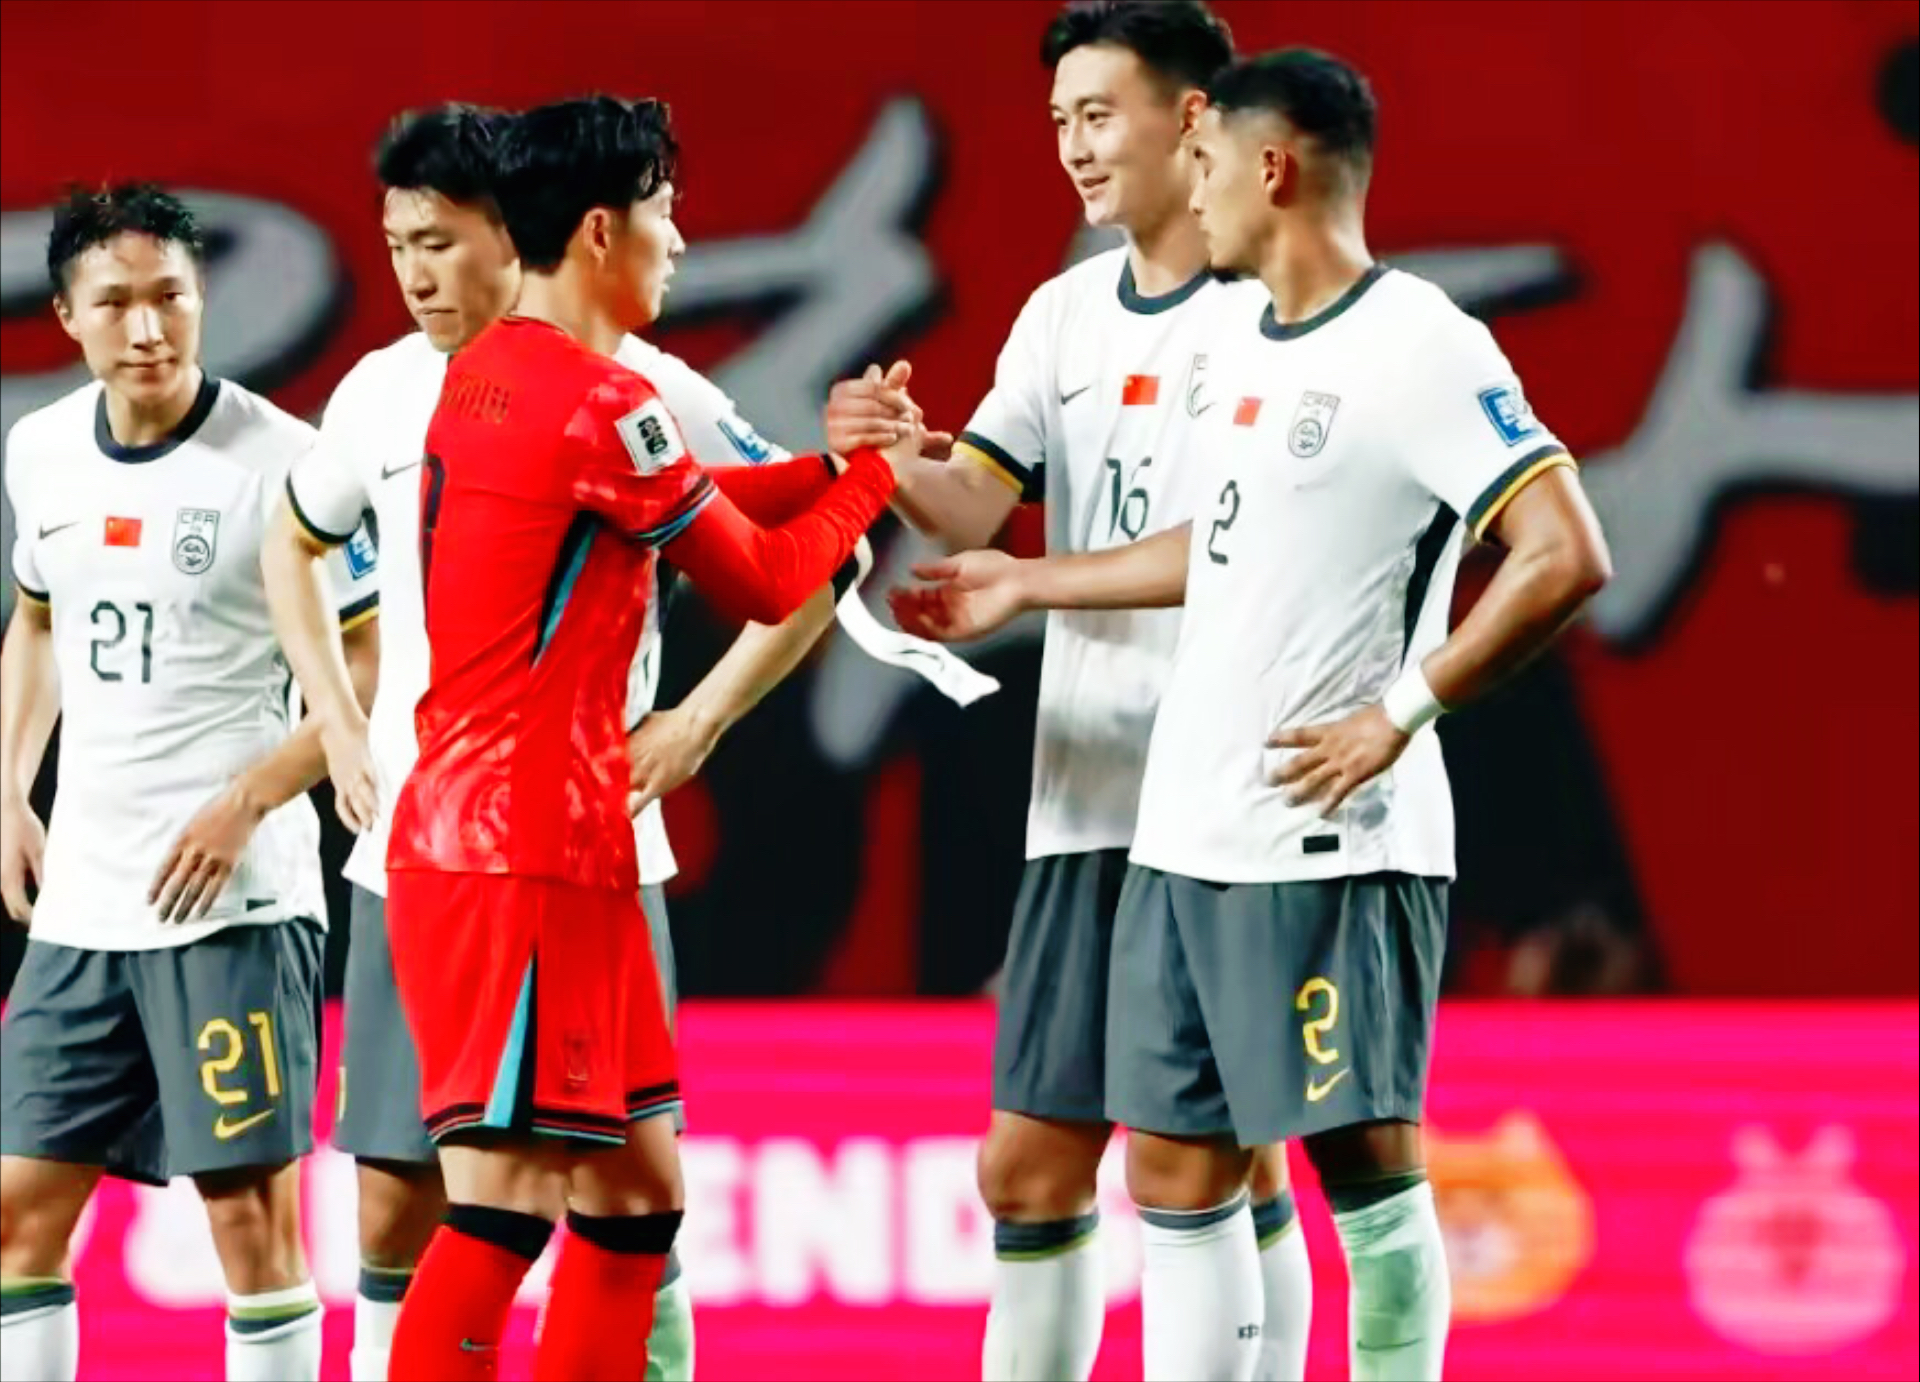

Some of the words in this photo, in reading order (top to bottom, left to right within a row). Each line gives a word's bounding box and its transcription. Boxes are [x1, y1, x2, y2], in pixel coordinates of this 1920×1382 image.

[1105, 456, 1153, 542] 16
[1208, 479, 1240, 565] 2
[90, 600, 153, 684] 21
[198, 1012, 280, 1105] 21
[1297, 977, 1339, 1064] 2
